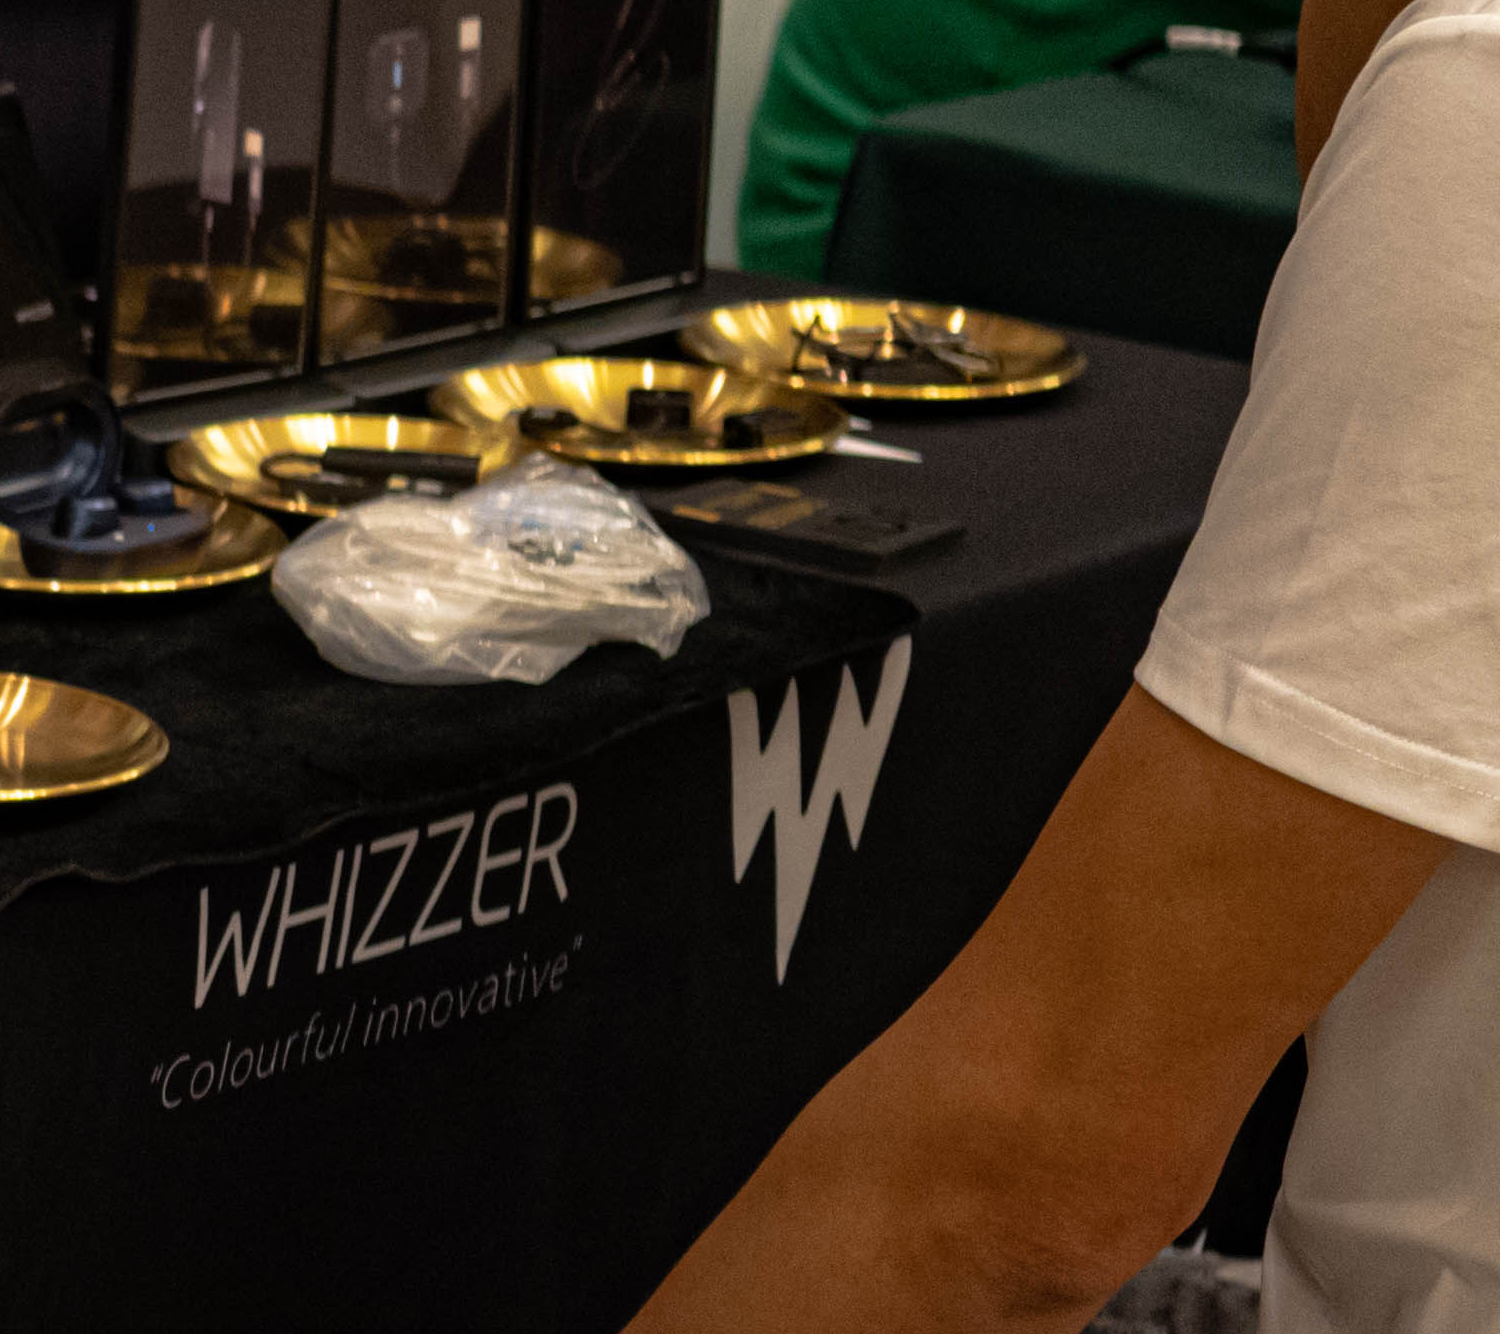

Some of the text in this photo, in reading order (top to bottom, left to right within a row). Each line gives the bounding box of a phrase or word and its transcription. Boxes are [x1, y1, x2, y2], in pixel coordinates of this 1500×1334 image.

[194, 782, 578, 1010] WHIZZER
[150, 934, 583, 1109] "Colourful innovative"
